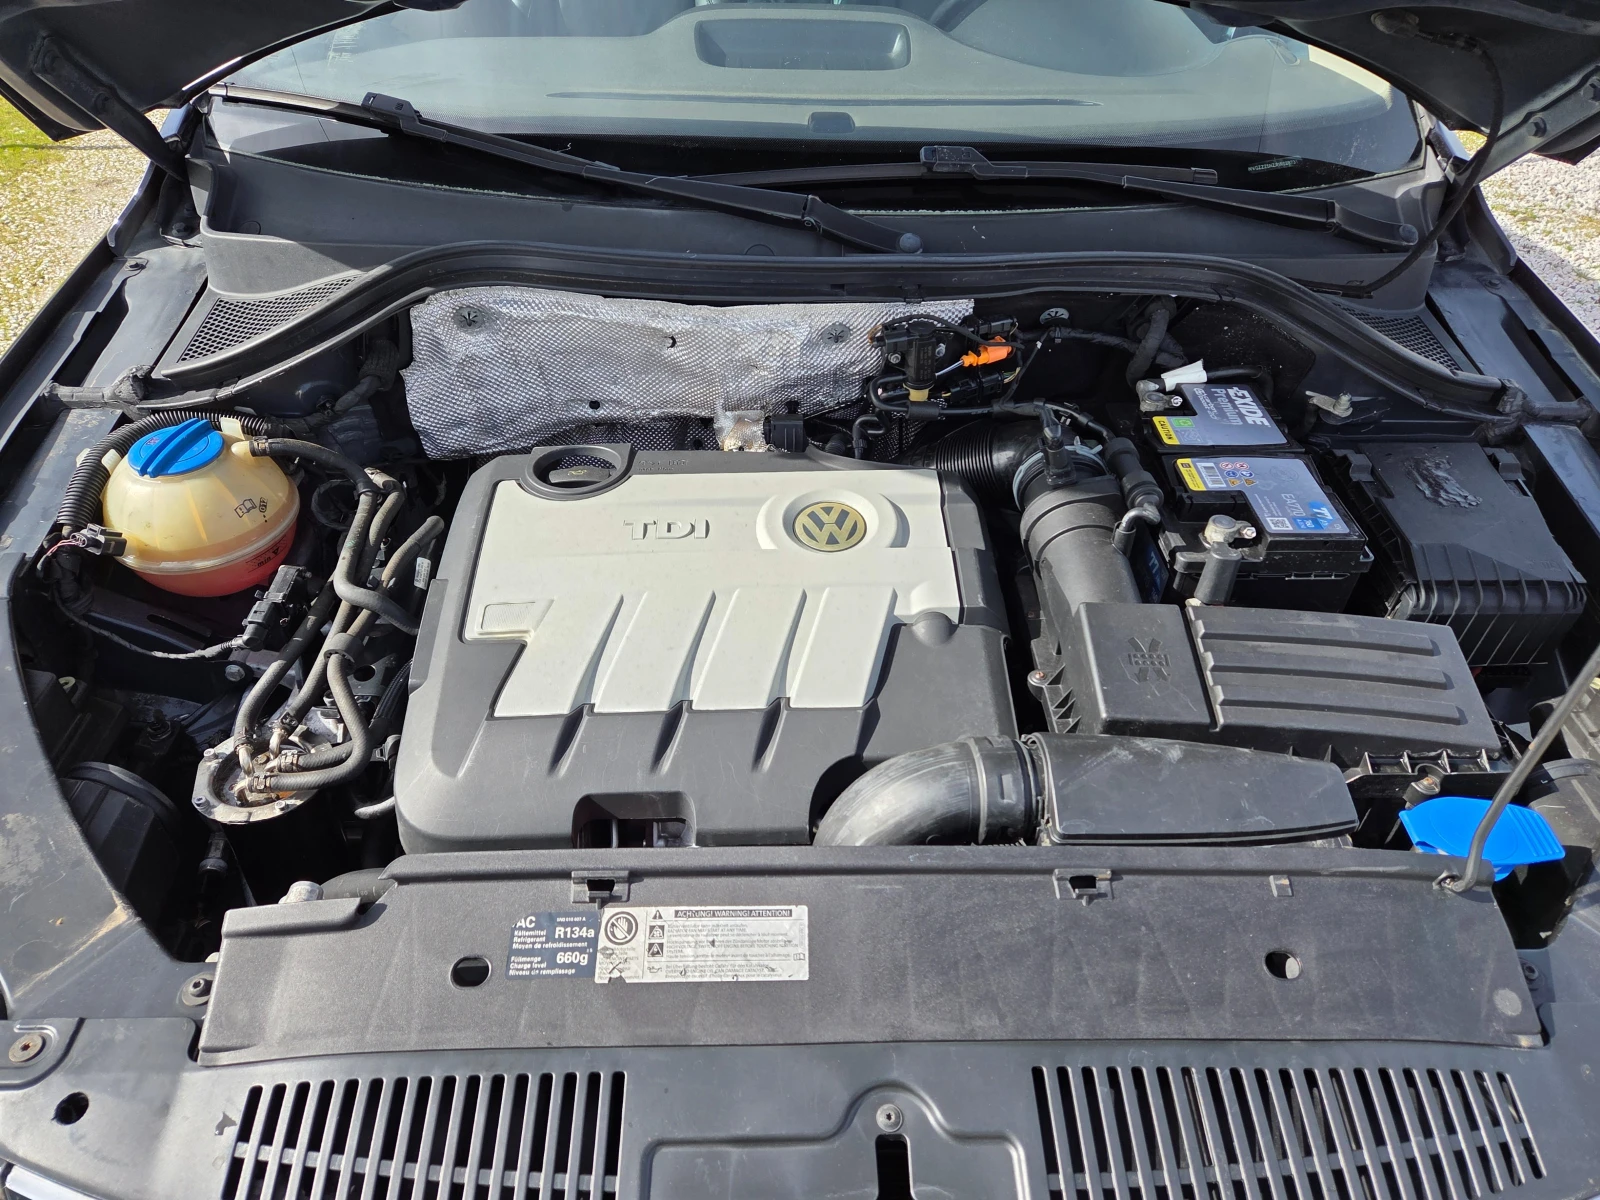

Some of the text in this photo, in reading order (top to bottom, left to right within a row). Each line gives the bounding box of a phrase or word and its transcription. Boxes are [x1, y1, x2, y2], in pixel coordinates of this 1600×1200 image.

[1211, 388, 1243, 425] Premium
[1227, 387, 1270, 427] EXIDE
[1158, 420, 1173, 440] CAUTION
[1281, 493, 1306, 517] EA770
[1312, 507, 1334, 520] 77
[623, 518, 710, 541] TDI
[257, 556, 272, 567] min
[515, 916, 536, 929] AC
[555, 926, 595, 939] R134a
[556, 952, 589, 966] 660g
